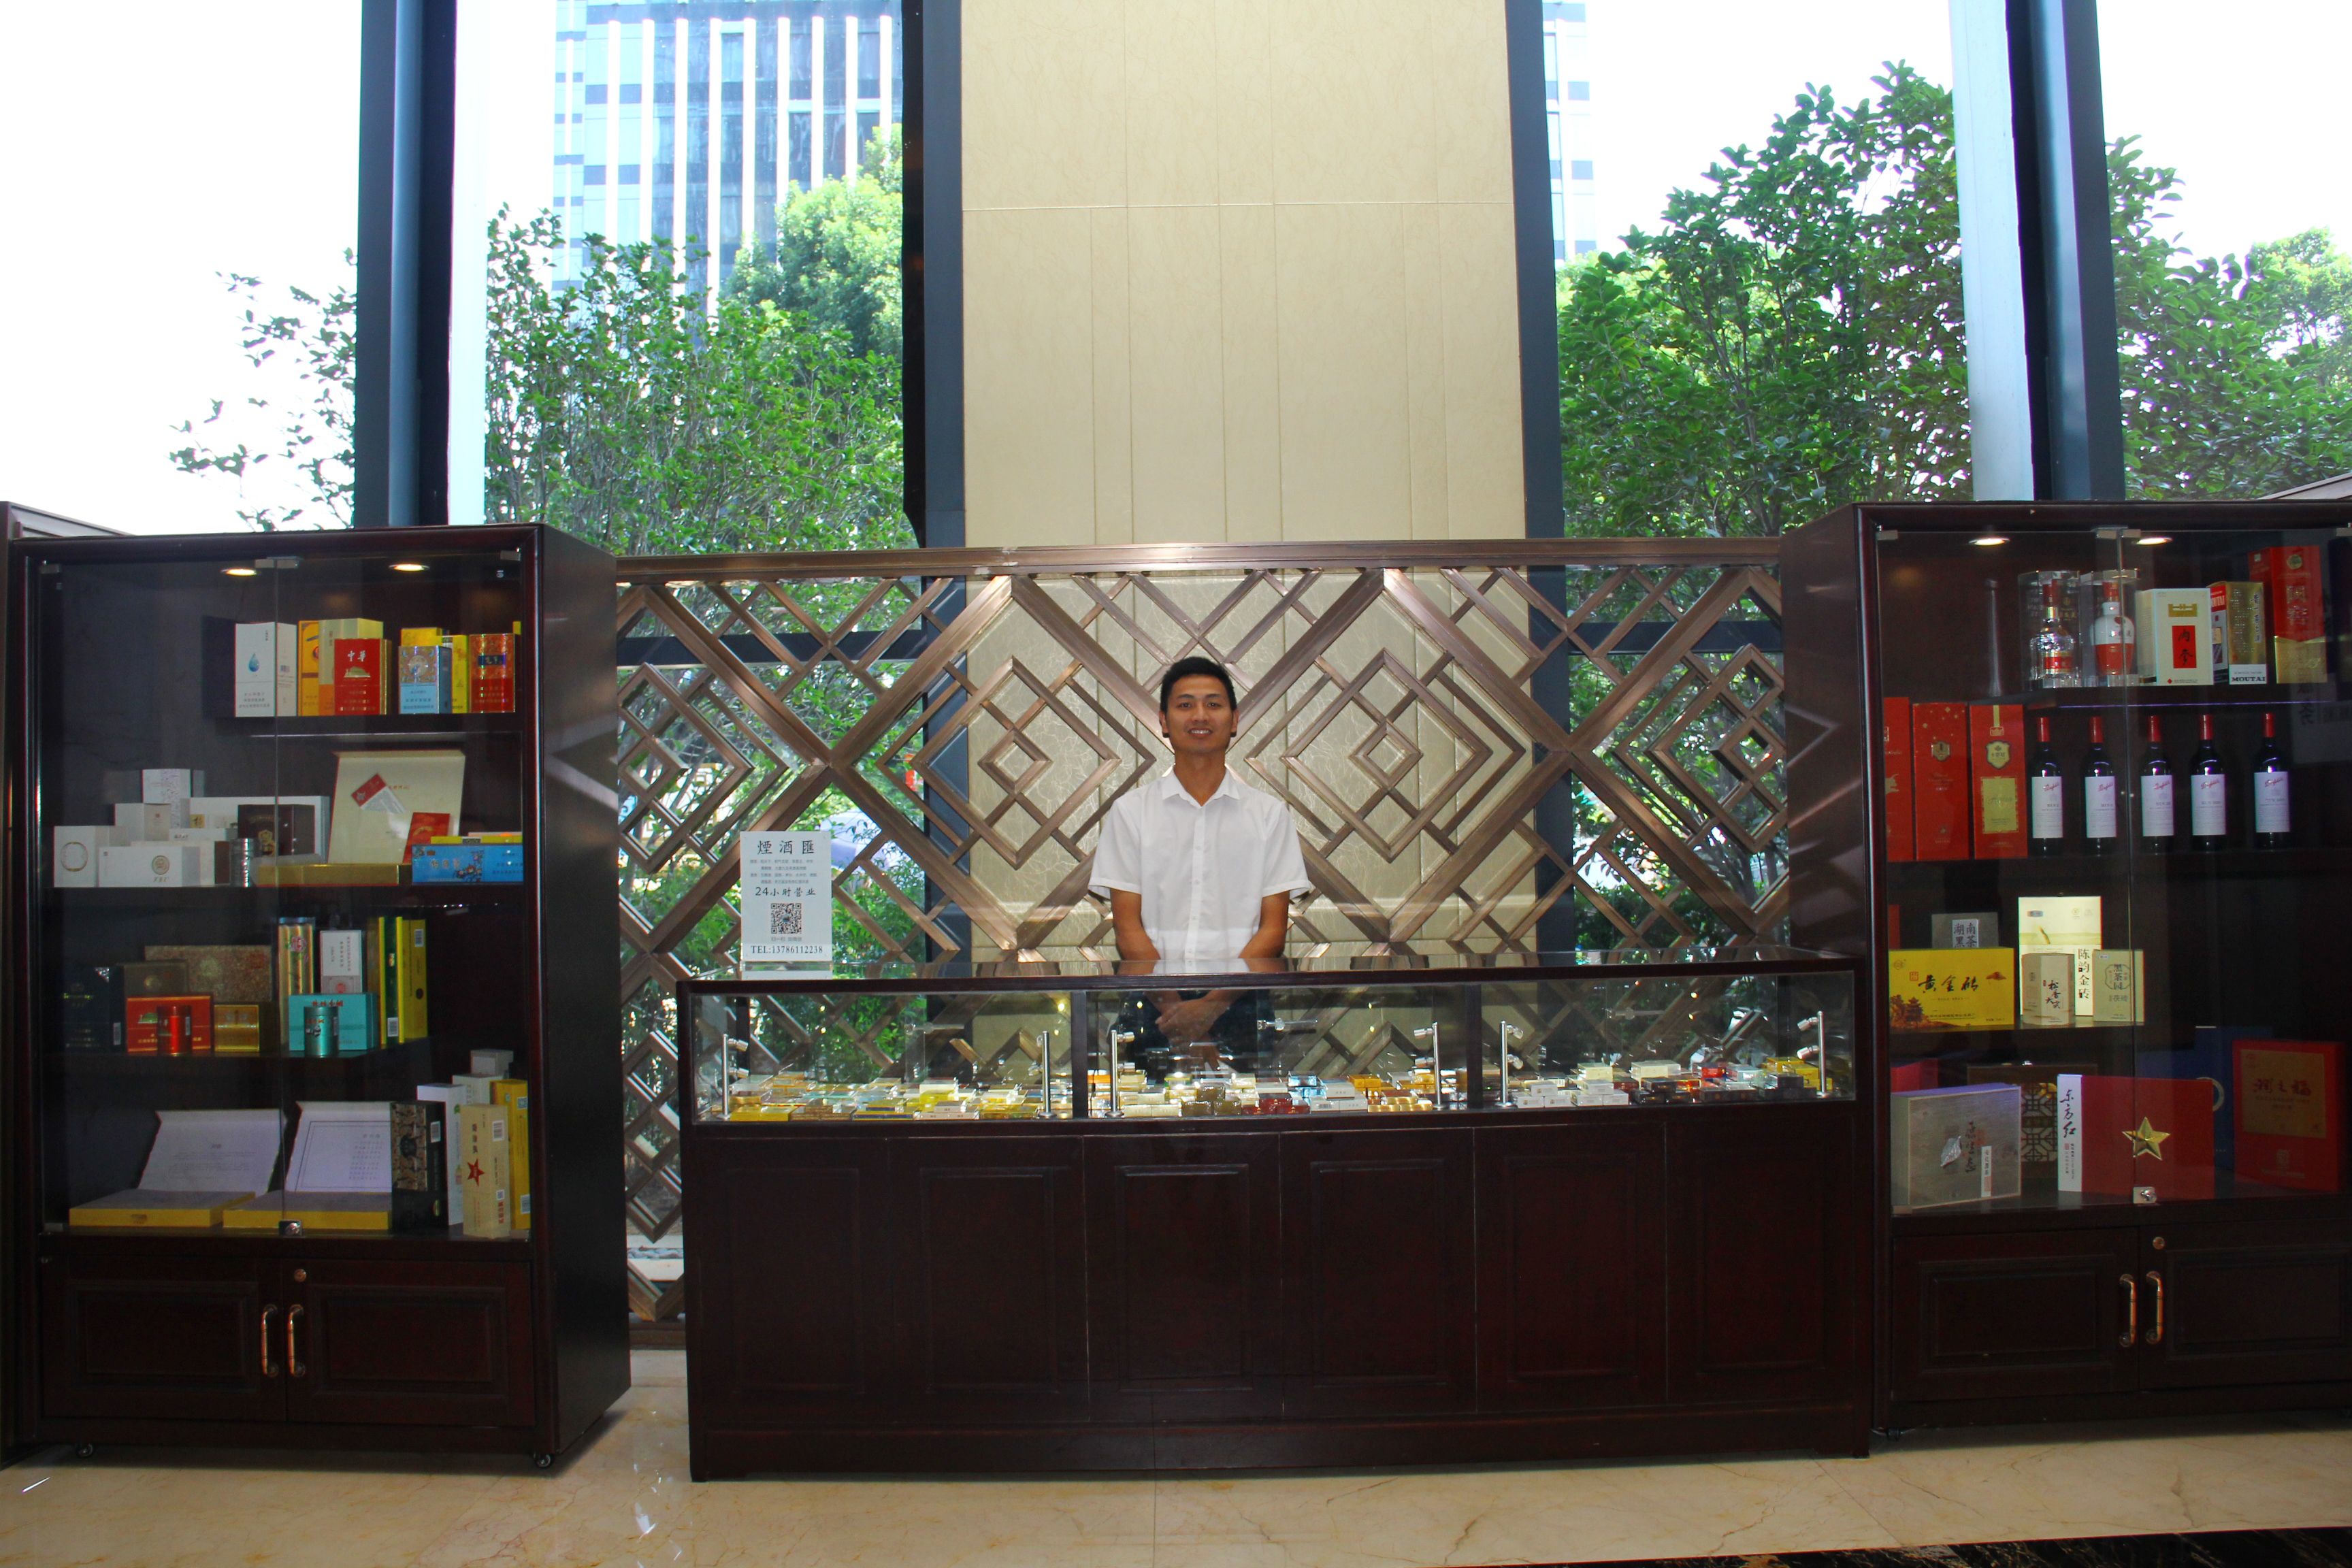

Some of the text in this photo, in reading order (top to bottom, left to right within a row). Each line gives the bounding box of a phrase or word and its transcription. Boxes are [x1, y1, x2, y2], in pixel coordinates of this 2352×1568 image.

[347, 650, 366, 662] 中華
[757, 840, 815, 855] 煙酒匯
[755, 887, 816, 897] 24小时营业
[1953, 922, 1976, 935] 湖南
[751, 945, 823, 954] TEL:13786112238
[2078, 948, 2091, 1000] 陈韵金砖
[1918, 974, 1979, 994] 黄金砖
[2059, 1089, 2077, 1138] 东方红
